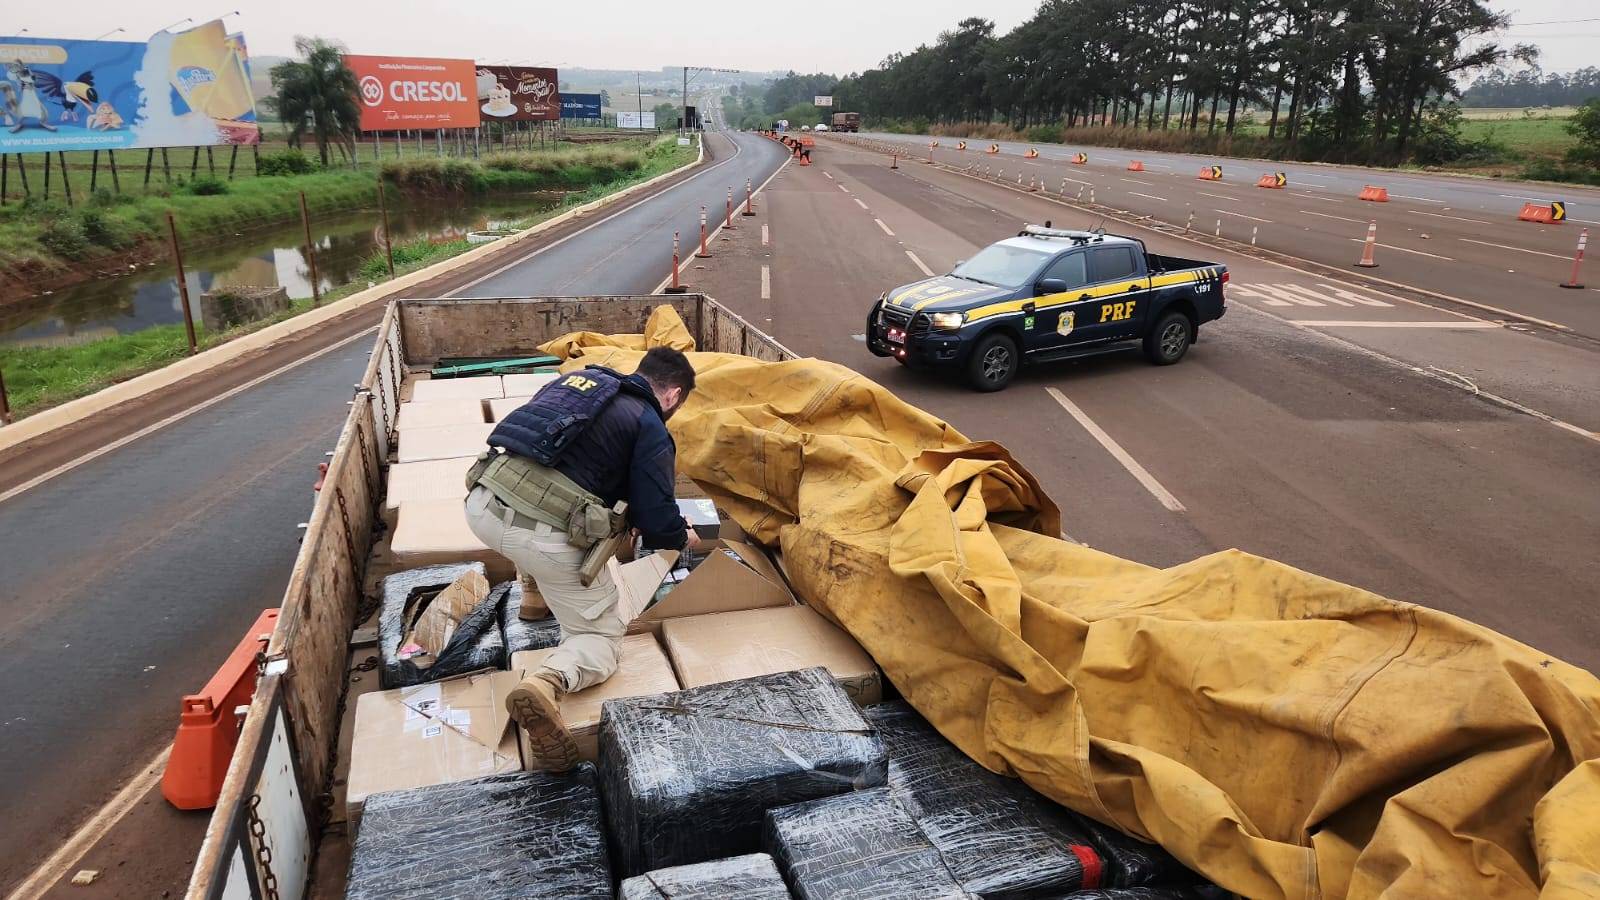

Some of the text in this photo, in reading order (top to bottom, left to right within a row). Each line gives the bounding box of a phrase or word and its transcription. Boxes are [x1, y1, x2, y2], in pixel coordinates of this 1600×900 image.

[389, 80, 468, 102] CRESOL
[1199, 284, 1211, 293] 191
[1099, 301, 1136, 323] PRF
[561, 375, 598, 391] PRF
